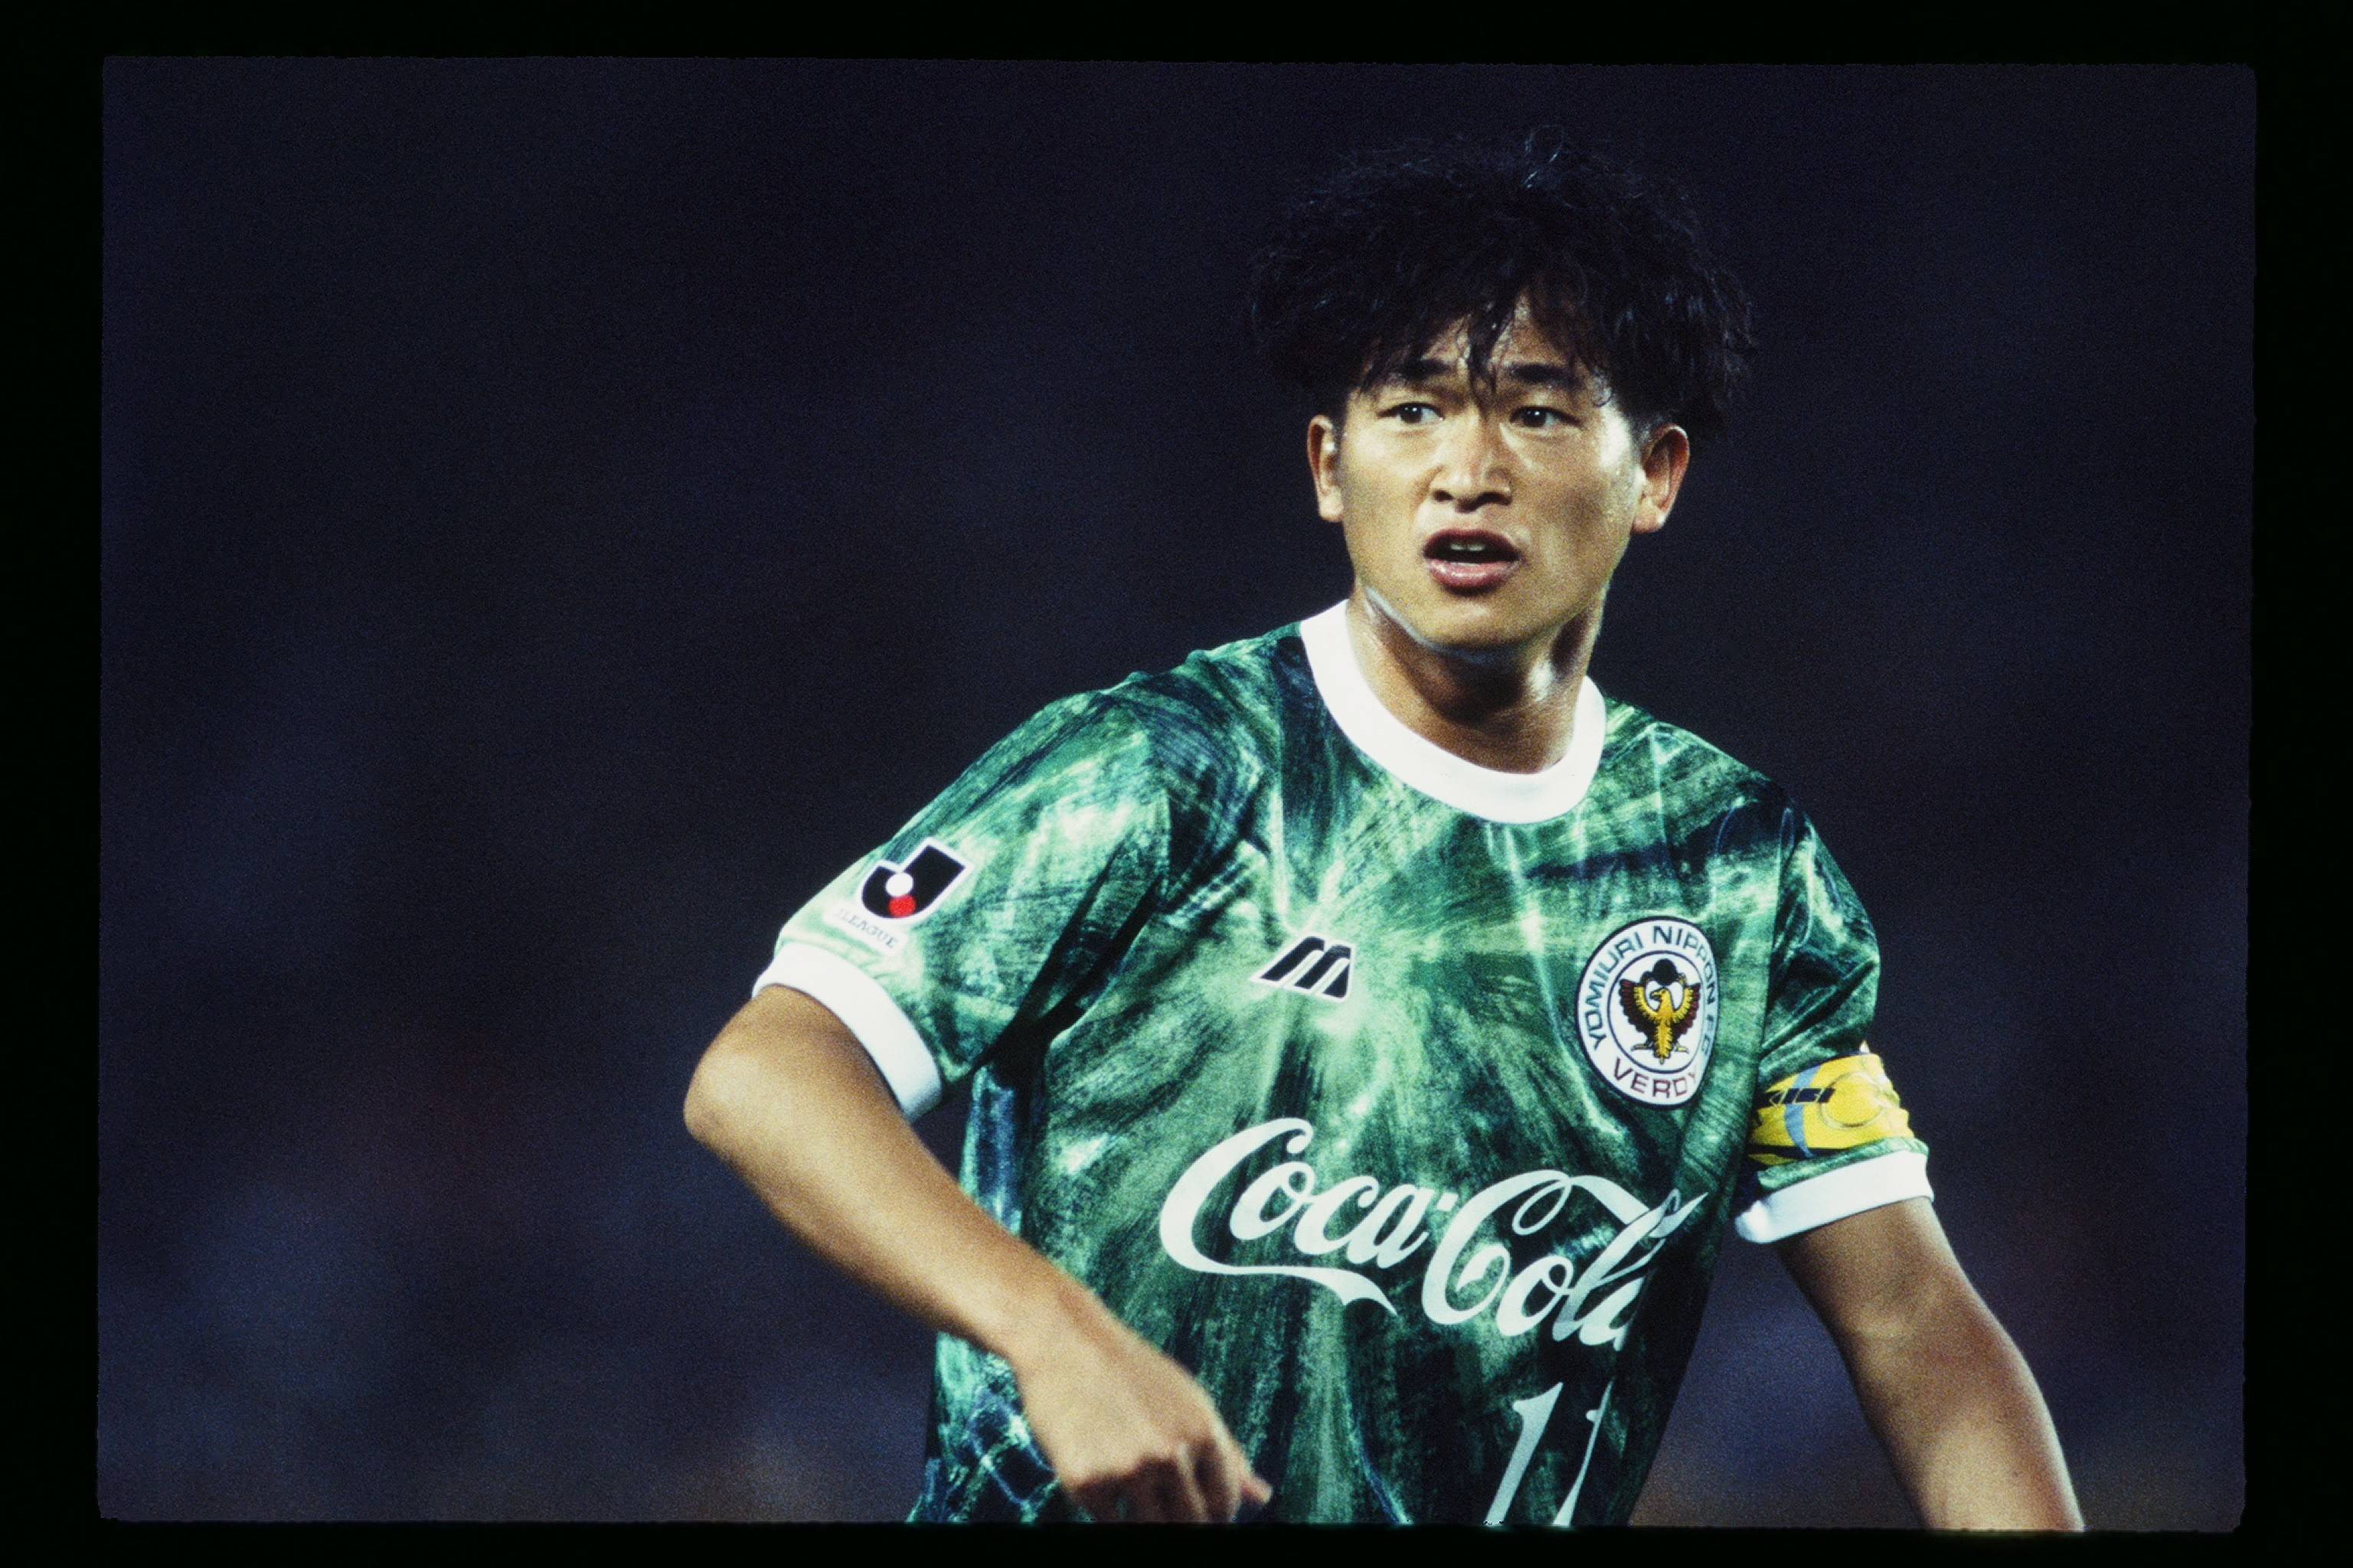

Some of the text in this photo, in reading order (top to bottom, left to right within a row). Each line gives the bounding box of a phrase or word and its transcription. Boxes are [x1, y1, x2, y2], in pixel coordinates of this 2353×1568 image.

[1584, 932, 1645, 1050] YOMIURI
[1652, 926, 1716, 1005] NIPPON
[1613, 1057, 1698, 1099] VERDY
